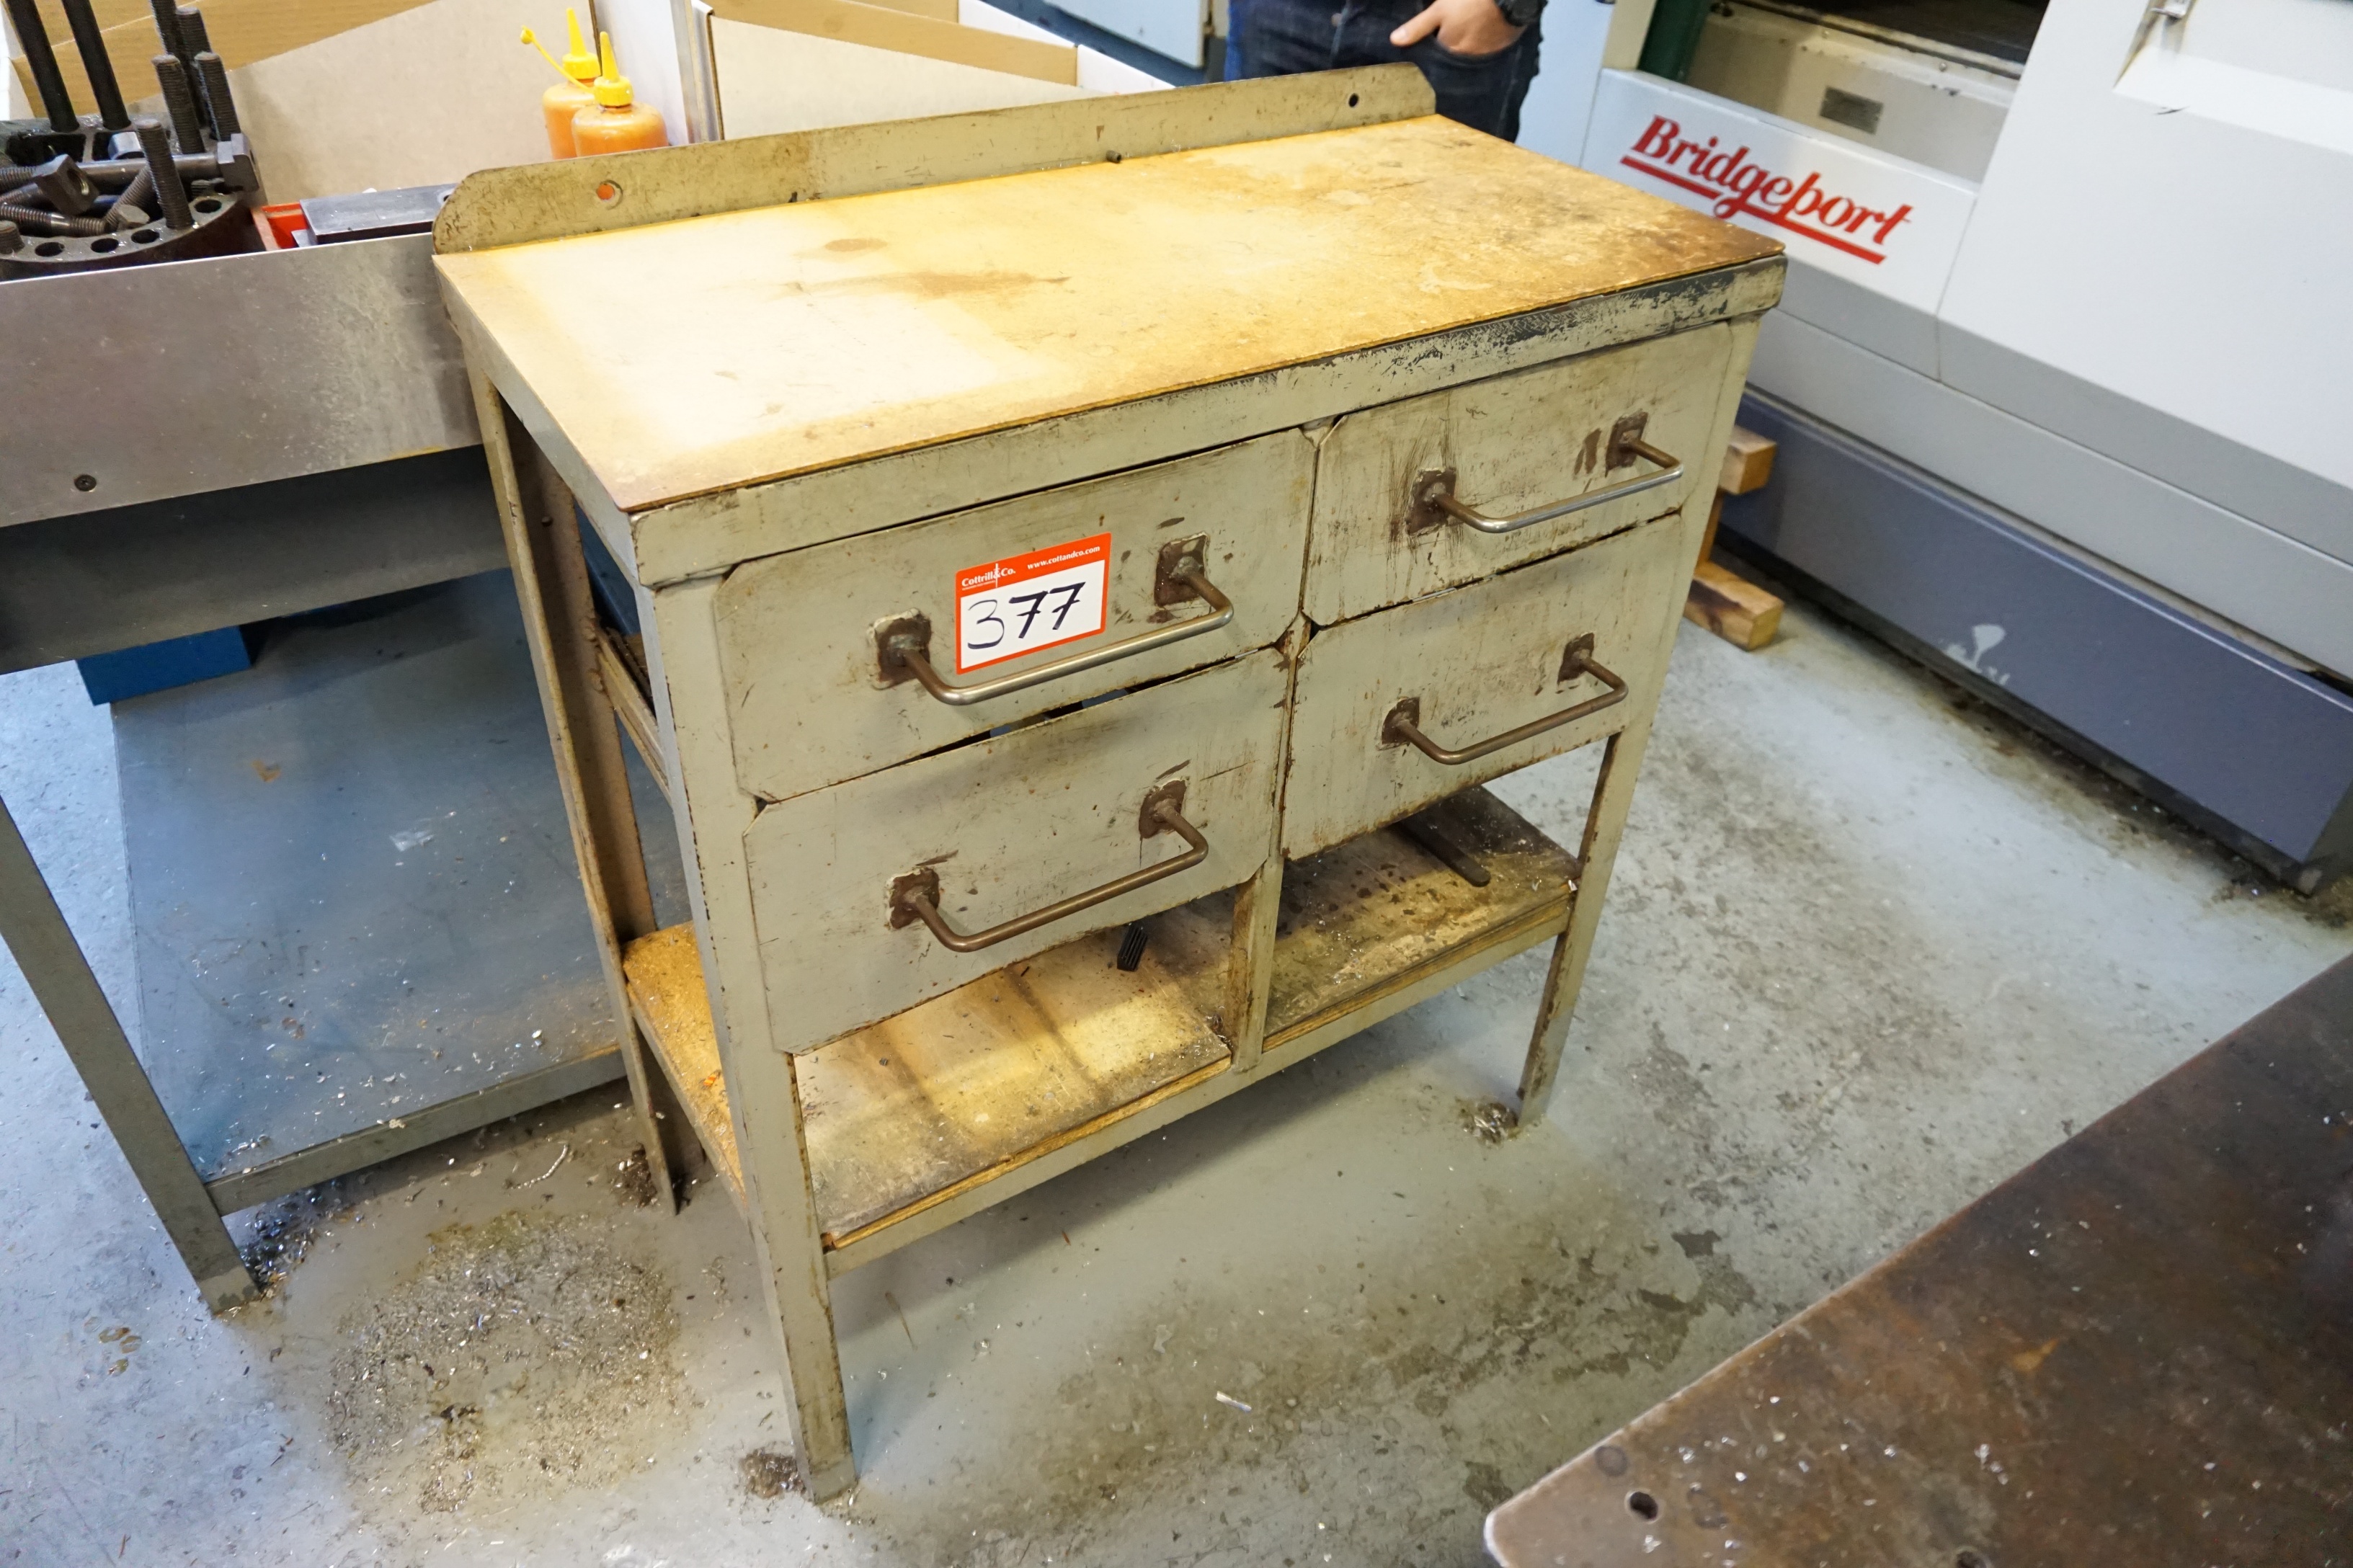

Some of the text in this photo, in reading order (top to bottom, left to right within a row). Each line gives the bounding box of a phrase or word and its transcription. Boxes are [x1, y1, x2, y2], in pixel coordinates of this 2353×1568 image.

[1632, 115, 1914, 246] Bridgeport
[1027, 546, 1100, 570] www.cottandco.com
[967, 582, 1086, 649] 377
